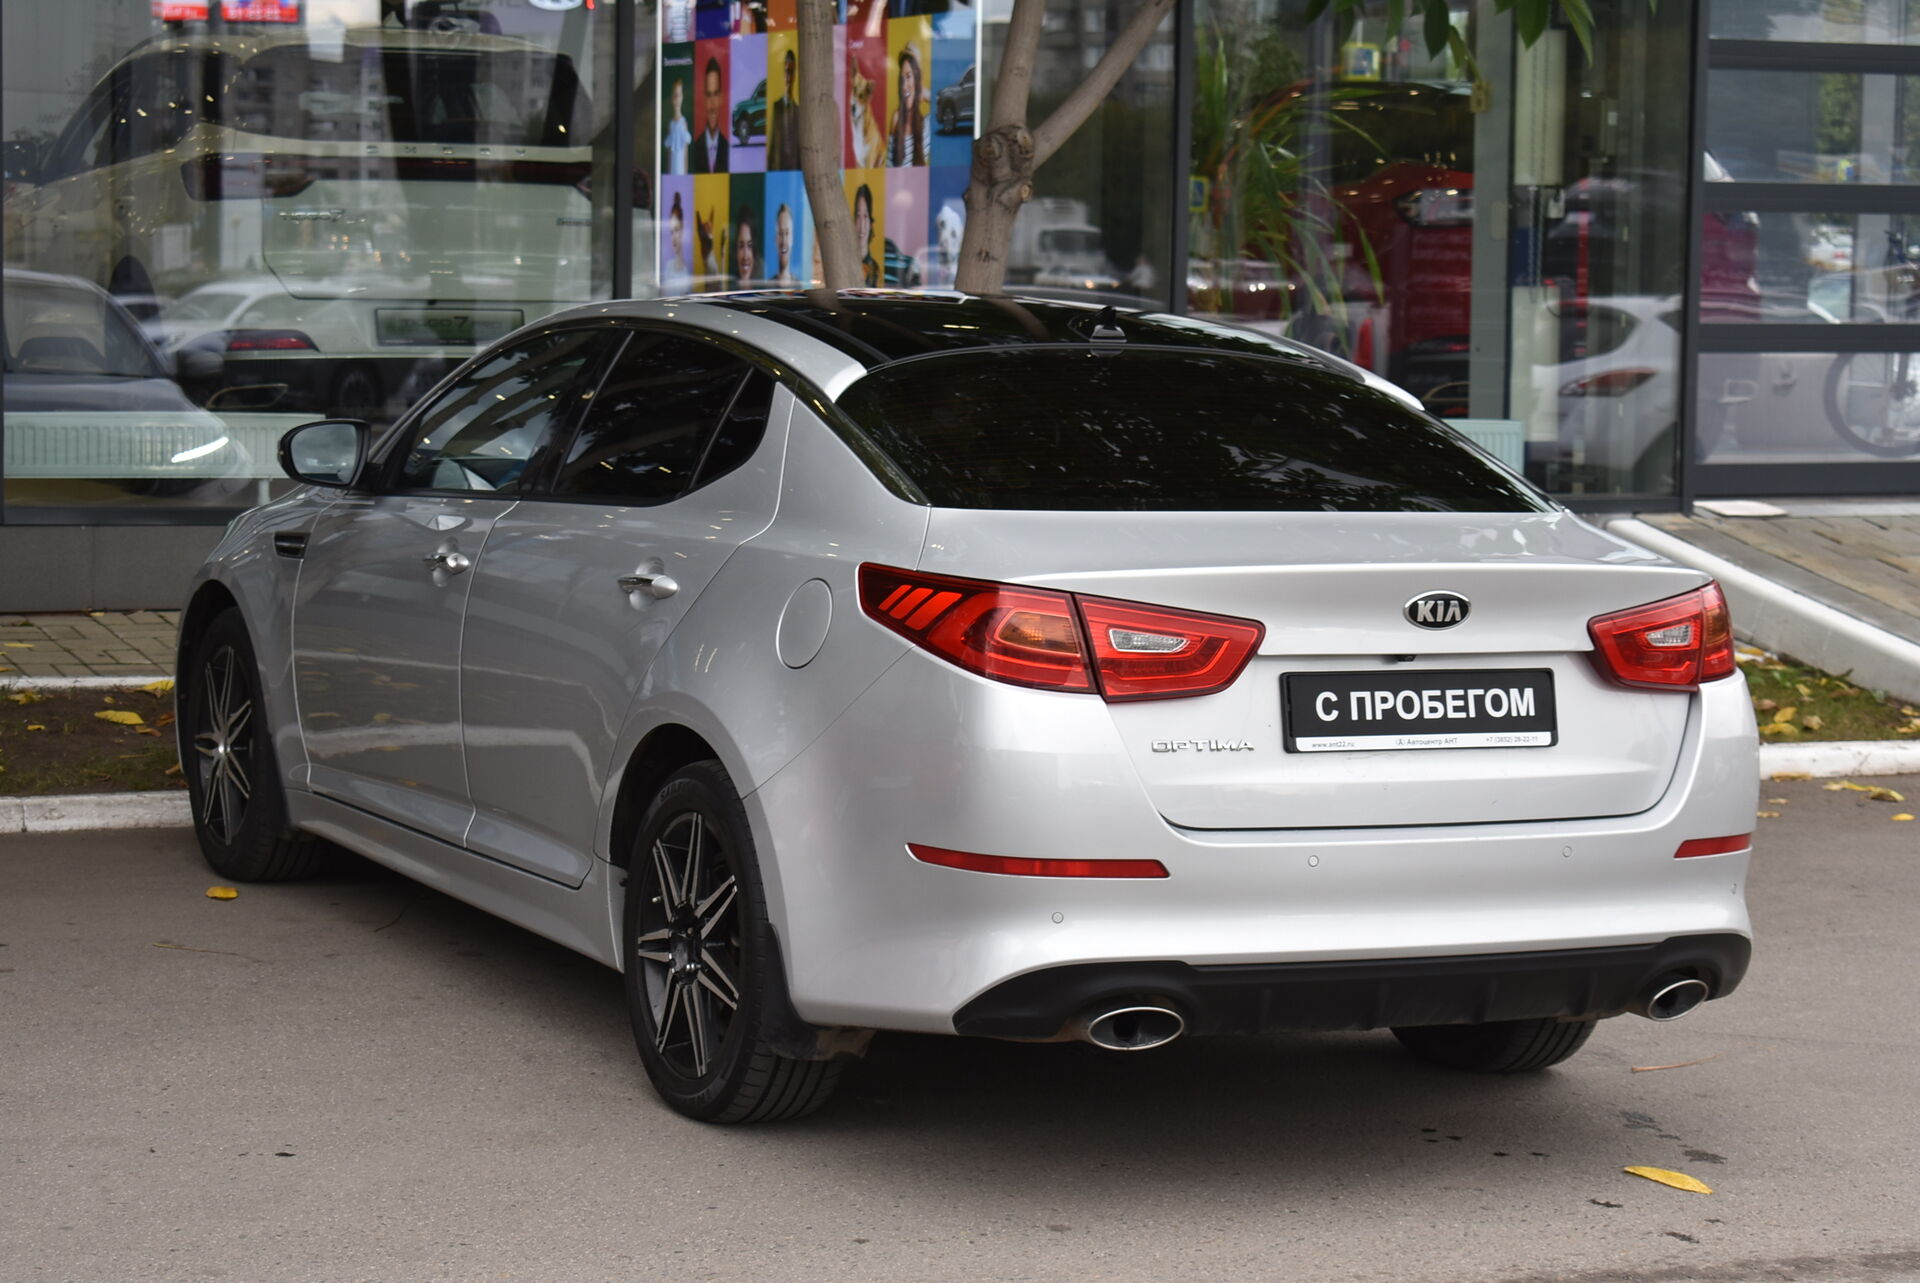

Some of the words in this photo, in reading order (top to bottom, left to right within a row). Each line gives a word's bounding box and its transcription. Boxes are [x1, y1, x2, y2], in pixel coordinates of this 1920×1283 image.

[1416, 600, 1462, 622] KIA
[1315, 691, 1340, 721] С
[1350, 687, 1536, 721] ПРОБЕГОМ
[1151, 739, 1255, 753] OPTIMA
